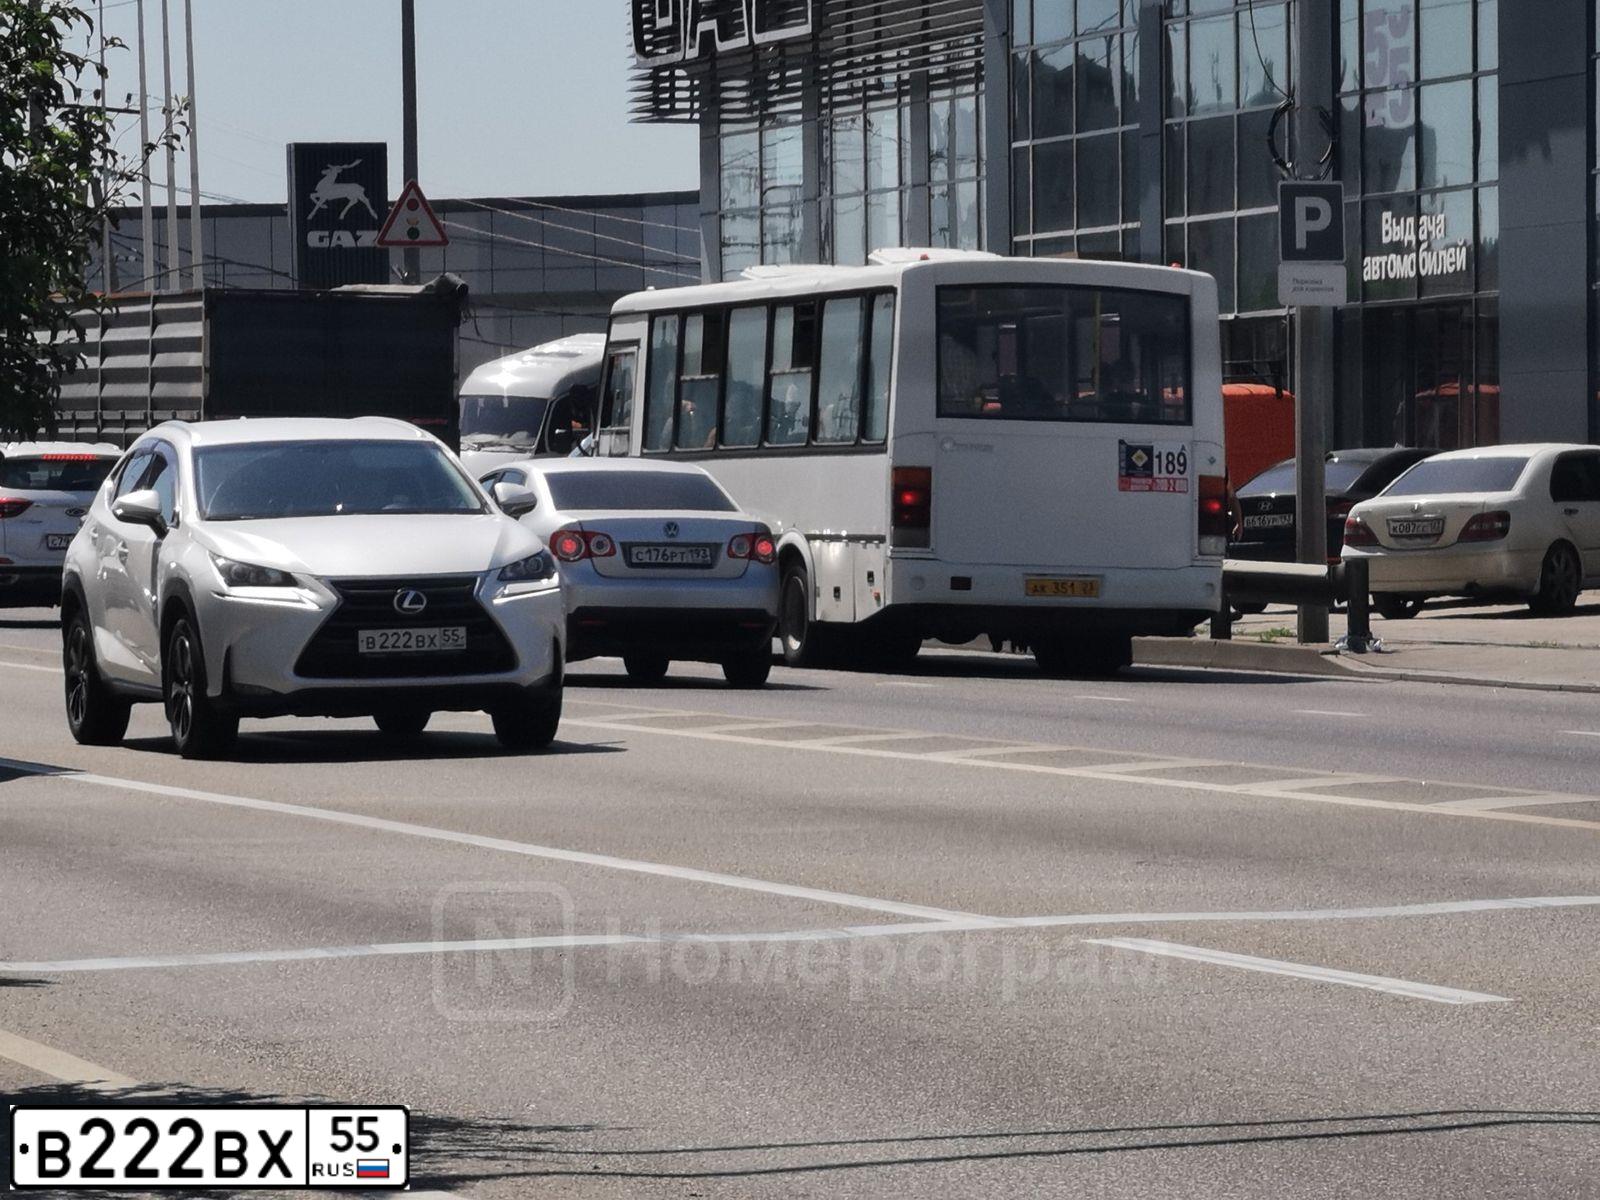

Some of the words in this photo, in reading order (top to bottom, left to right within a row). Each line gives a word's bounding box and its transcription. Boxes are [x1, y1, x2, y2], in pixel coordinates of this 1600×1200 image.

[1295, 196, 1332, 250] P
[1382, 211, 1445, 249] Выдача
[307, 230, 378, 248] GAZ
[1362, 237, 1467, 282] автомобилей
[1154, 450, 1188, 476] 189
[635, 548, 686, 562] С176РТ
[365, 631, 438, 650] В222ВХ
[442, 629, 461, 643] 55
